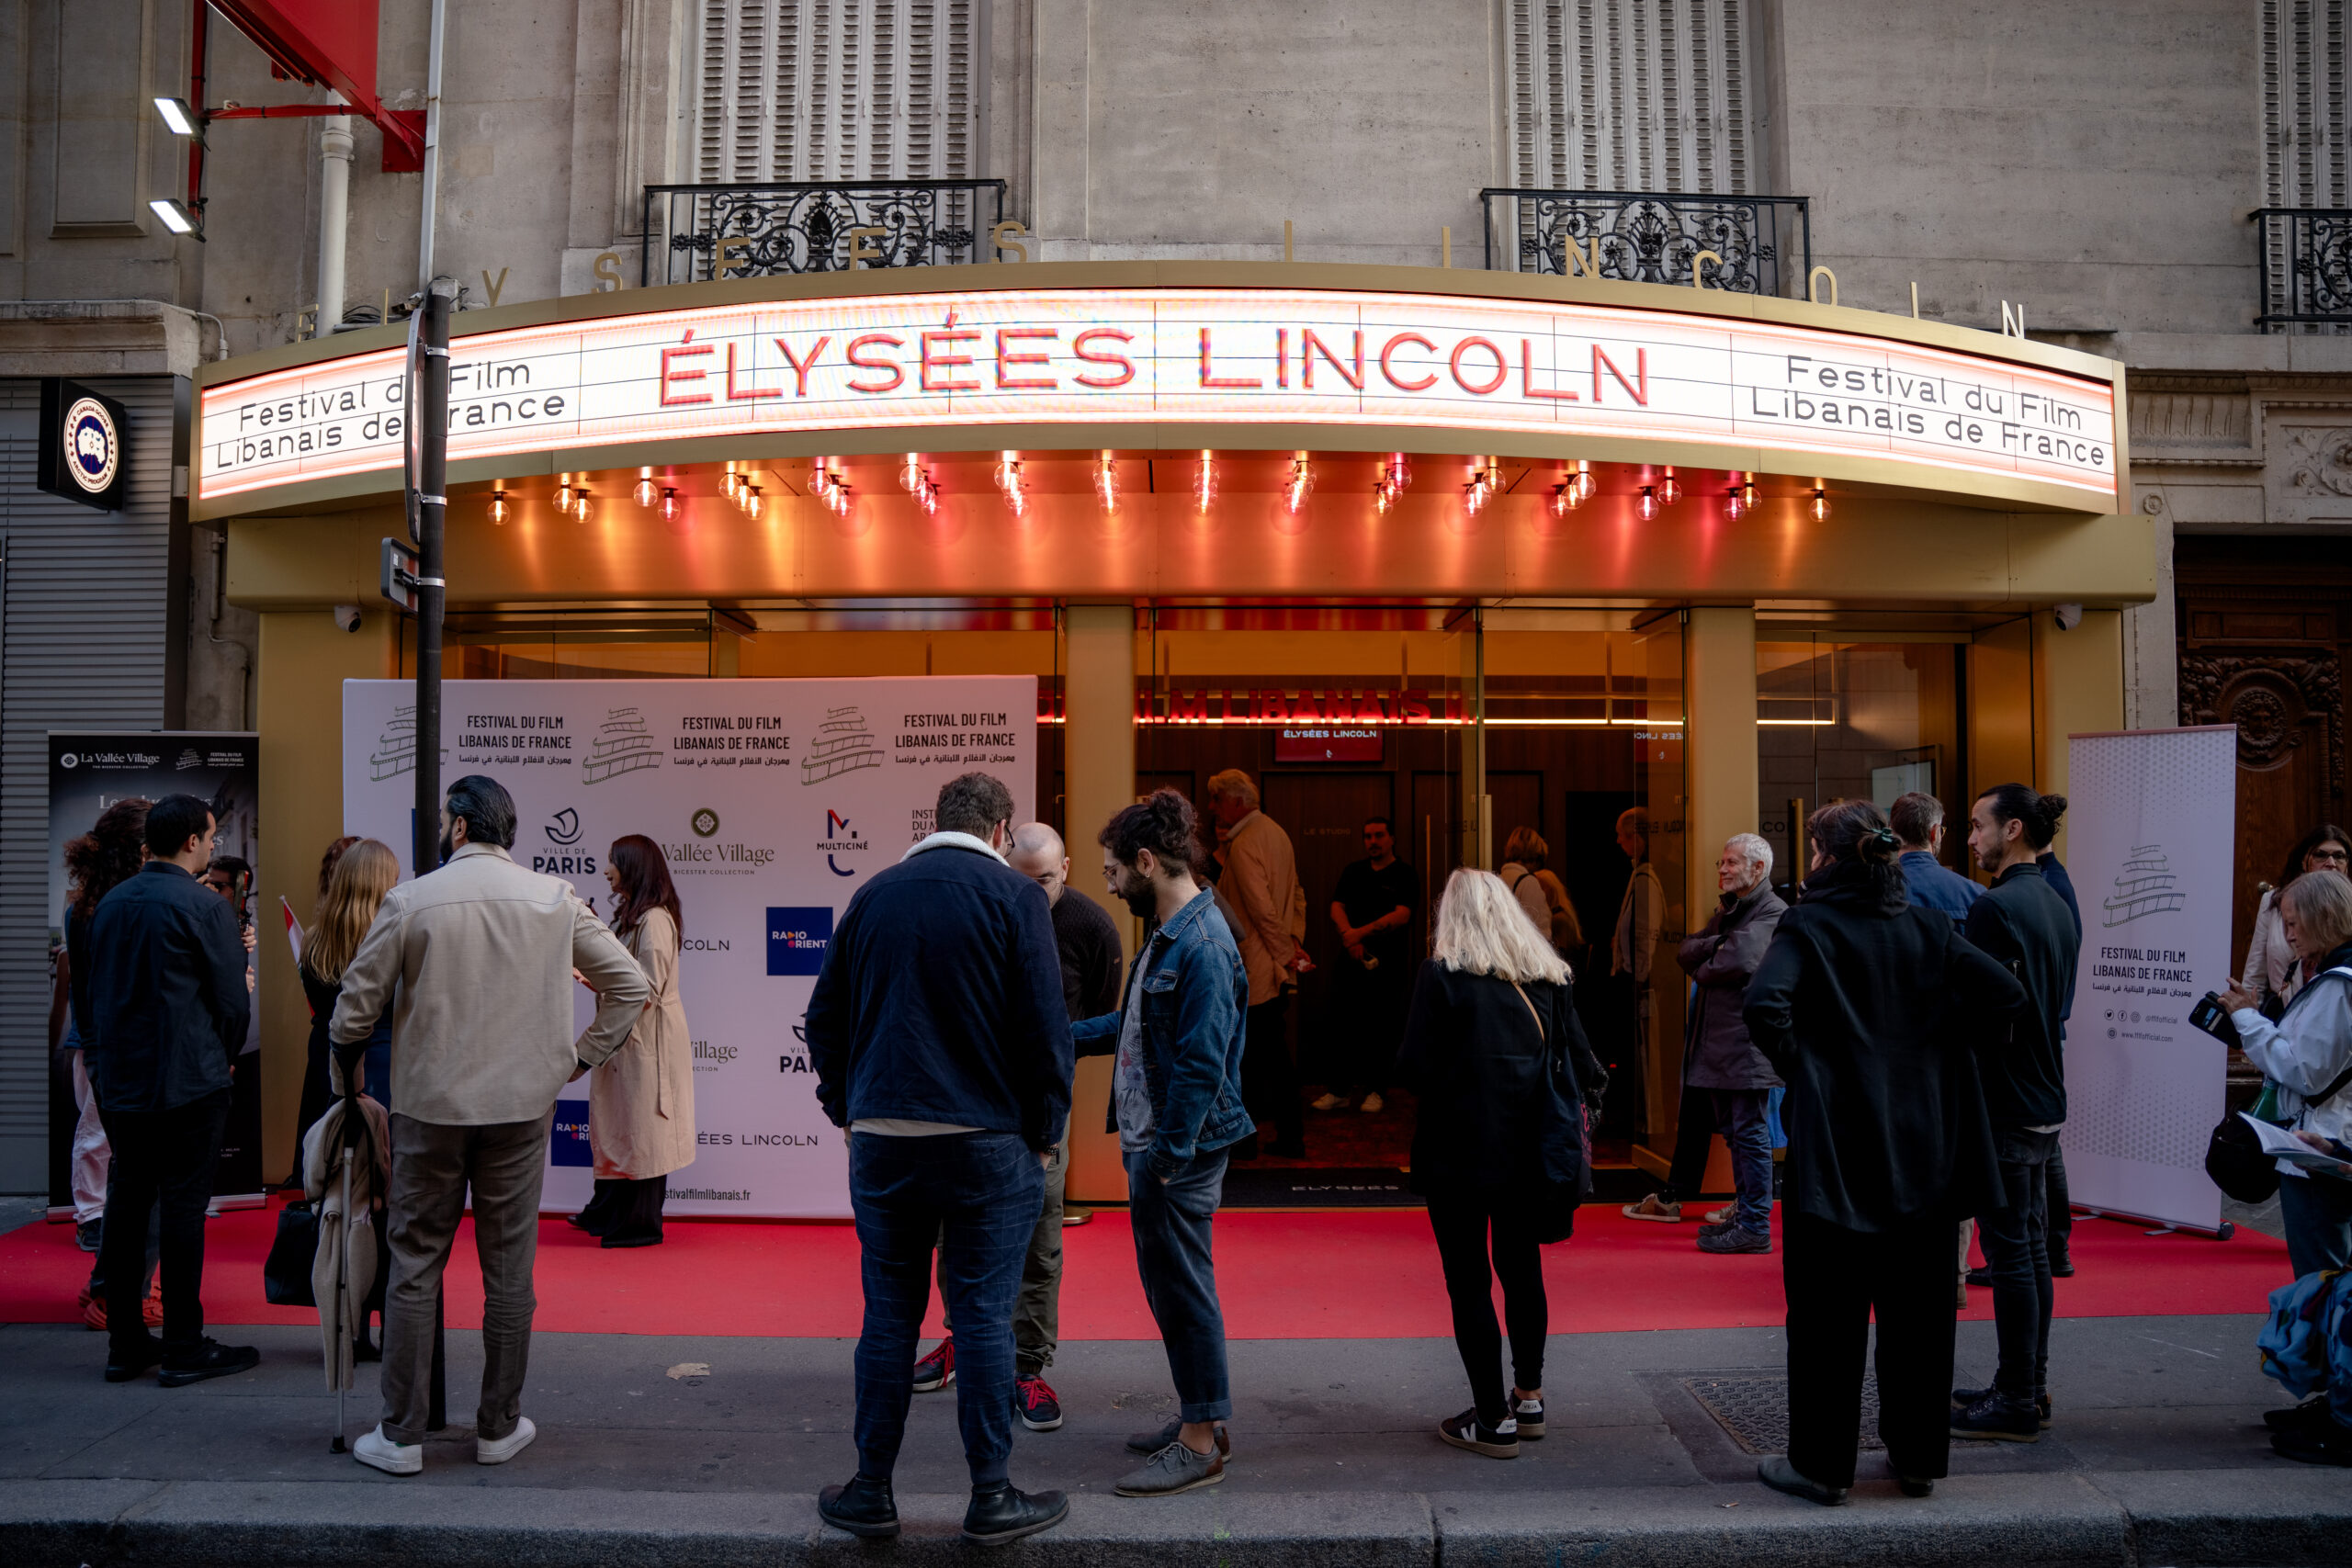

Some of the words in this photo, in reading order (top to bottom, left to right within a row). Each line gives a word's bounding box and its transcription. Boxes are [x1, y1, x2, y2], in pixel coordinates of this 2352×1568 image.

[660, 311, 1136, 406] ÉLYSÉES
[1199, 327, 1649, 407] LINCOLN
[239, 379, 366, 432] Festival
[385, 374, 404, 402] d
[447, 360, 530, 394] Film
[1787, 354, 1947, 405] Festival
[1965, 384, 2003, 416] du
[2020, 391, 2081, 431] Film
[217, 422, 343, 468] Libanais
[362, 412, 401, 441] de
[448, 393, 565, 428] rance
[1752, 386, 1925, 435] Libanais
[1945, 413, 1984, 444] de
[2000, 421, 2105, 466] France
[1222, 689, 1431, 724] LIBANAIS
[467, 715, 518, 728] FESTIVAL
[521, 716, 536, 728] DU
[538, 716, 563, 729] FILM
[683, 716, 734, 729] FESTIVAL
[738, 716, 752, 729] DU
[756, 716, 781, 729] FILM
[904, 714, 958, 728] FESTIVAL
[961, 713, 977, 727] DU
[980, 713, 1006, 726] FILM
[895, 734, 948, 748] LIBANAIS
[952, 734, 967, 747] DE
[969, 733, 1015, 746] FRANCE
[1283, 728, 1329, 739] ÉLYSÉES
[1333, 729, 1377, 739] LINCOLN
[458, 735, 509, 748] LIBANAIS
[512, 736, 526, 748] DE
[528, 736, 571, 749] FRANCE
[673, 737, 725, 750] LIBANAIS
[728, 737, 742, 750] DE
[745, 737, 790, 750] FRANCE
[81, 752, 94, 763] La
[95, 752, 126, 763] Vallée
[127, 752, 161, 766] Village
[458, 754, 480, 763] فرنسا
[481, 755, 492, 765] في
[673, 757, 695, 766] فرنسا
[696, 757, 707, 768] في
[895, 755, 917, 764] فرنسا
[920, 755, 930, 765] في
[911, 809, 934, 819] INST
[912, 820, 927, 830] DU
[817, 840, 868, 851] MULTICINÉ
[662, 843, 713, 862] Vallée
[717, 843, 775, 866] Village
[533, 856, 596, 874] PARIS
[683, 939, 729, 951] COLN
[2101, 946, 2144, 961] FESTIVAL
[2147, 949, 2161, 962] DU
[2163, 950, 2186, 964] FILM
[2093, 964, 2136, 979] LIBANAIS
[2138, 967, 2151, 980] DE
[2153, 968, 2193, 983] FRANCE
[691, 1041, 738, 1064] illage
[741, 1134, 818, 1146] LINCOLN
[664, 1188, 751, 1201] stivalfilmlibanais.fr
